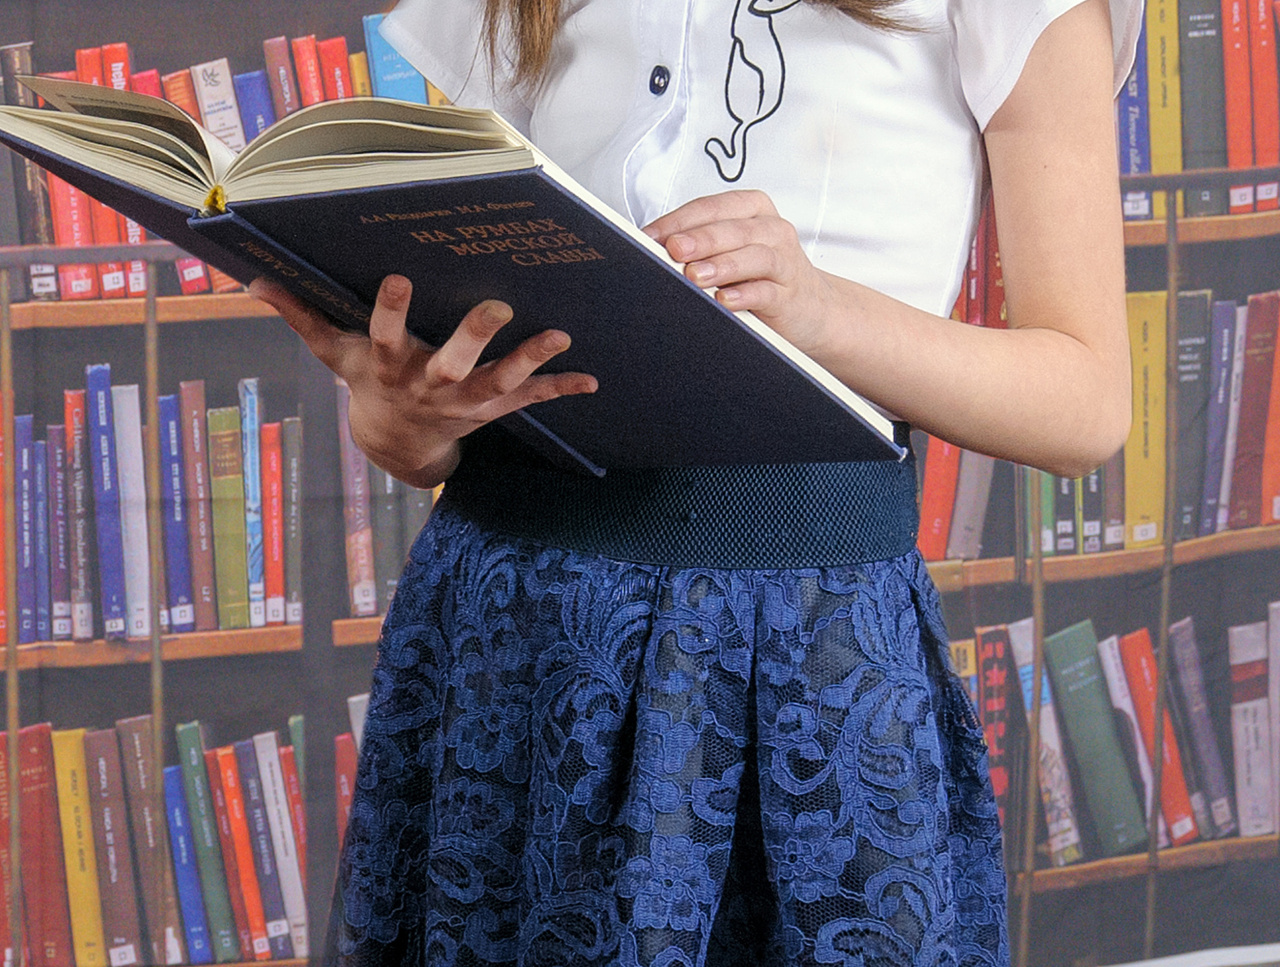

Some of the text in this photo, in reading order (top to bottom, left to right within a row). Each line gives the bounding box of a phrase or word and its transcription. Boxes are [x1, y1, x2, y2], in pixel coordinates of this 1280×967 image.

[410, 218, 567, 244] НА РУМБАХ
[446, 232, 586, 256] МОРСКОЙ
[510, 247, 606, 266] СЛАВЫ
